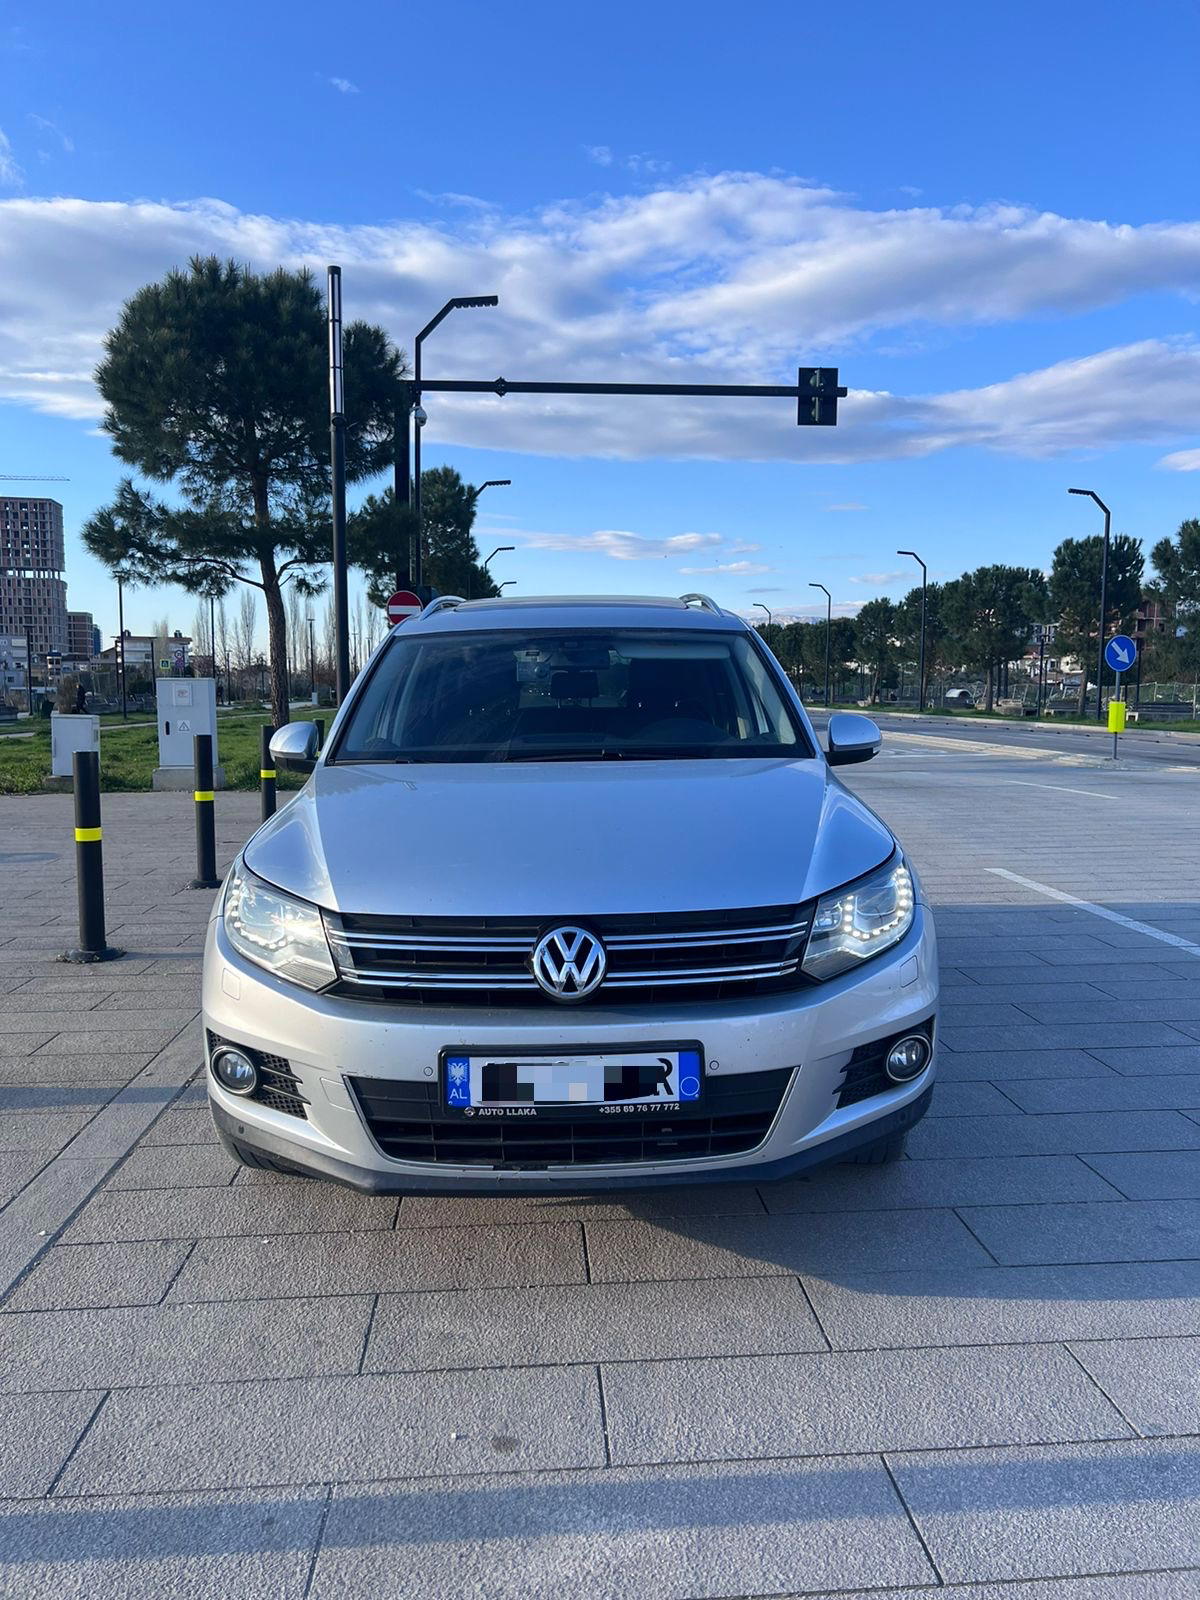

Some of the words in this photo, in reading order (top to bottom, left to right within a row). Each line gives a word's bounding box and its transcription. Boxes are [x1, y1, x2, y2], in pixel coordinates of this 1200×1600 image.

[450, 1088, 468, 1099] AL
[479, 1108, 504, 1116] AUTO
[506, 1108, 537, 1116] LLAKA
[599, 1106, 621, 1114] +355
[663, 1103, 680, 1111] 772
